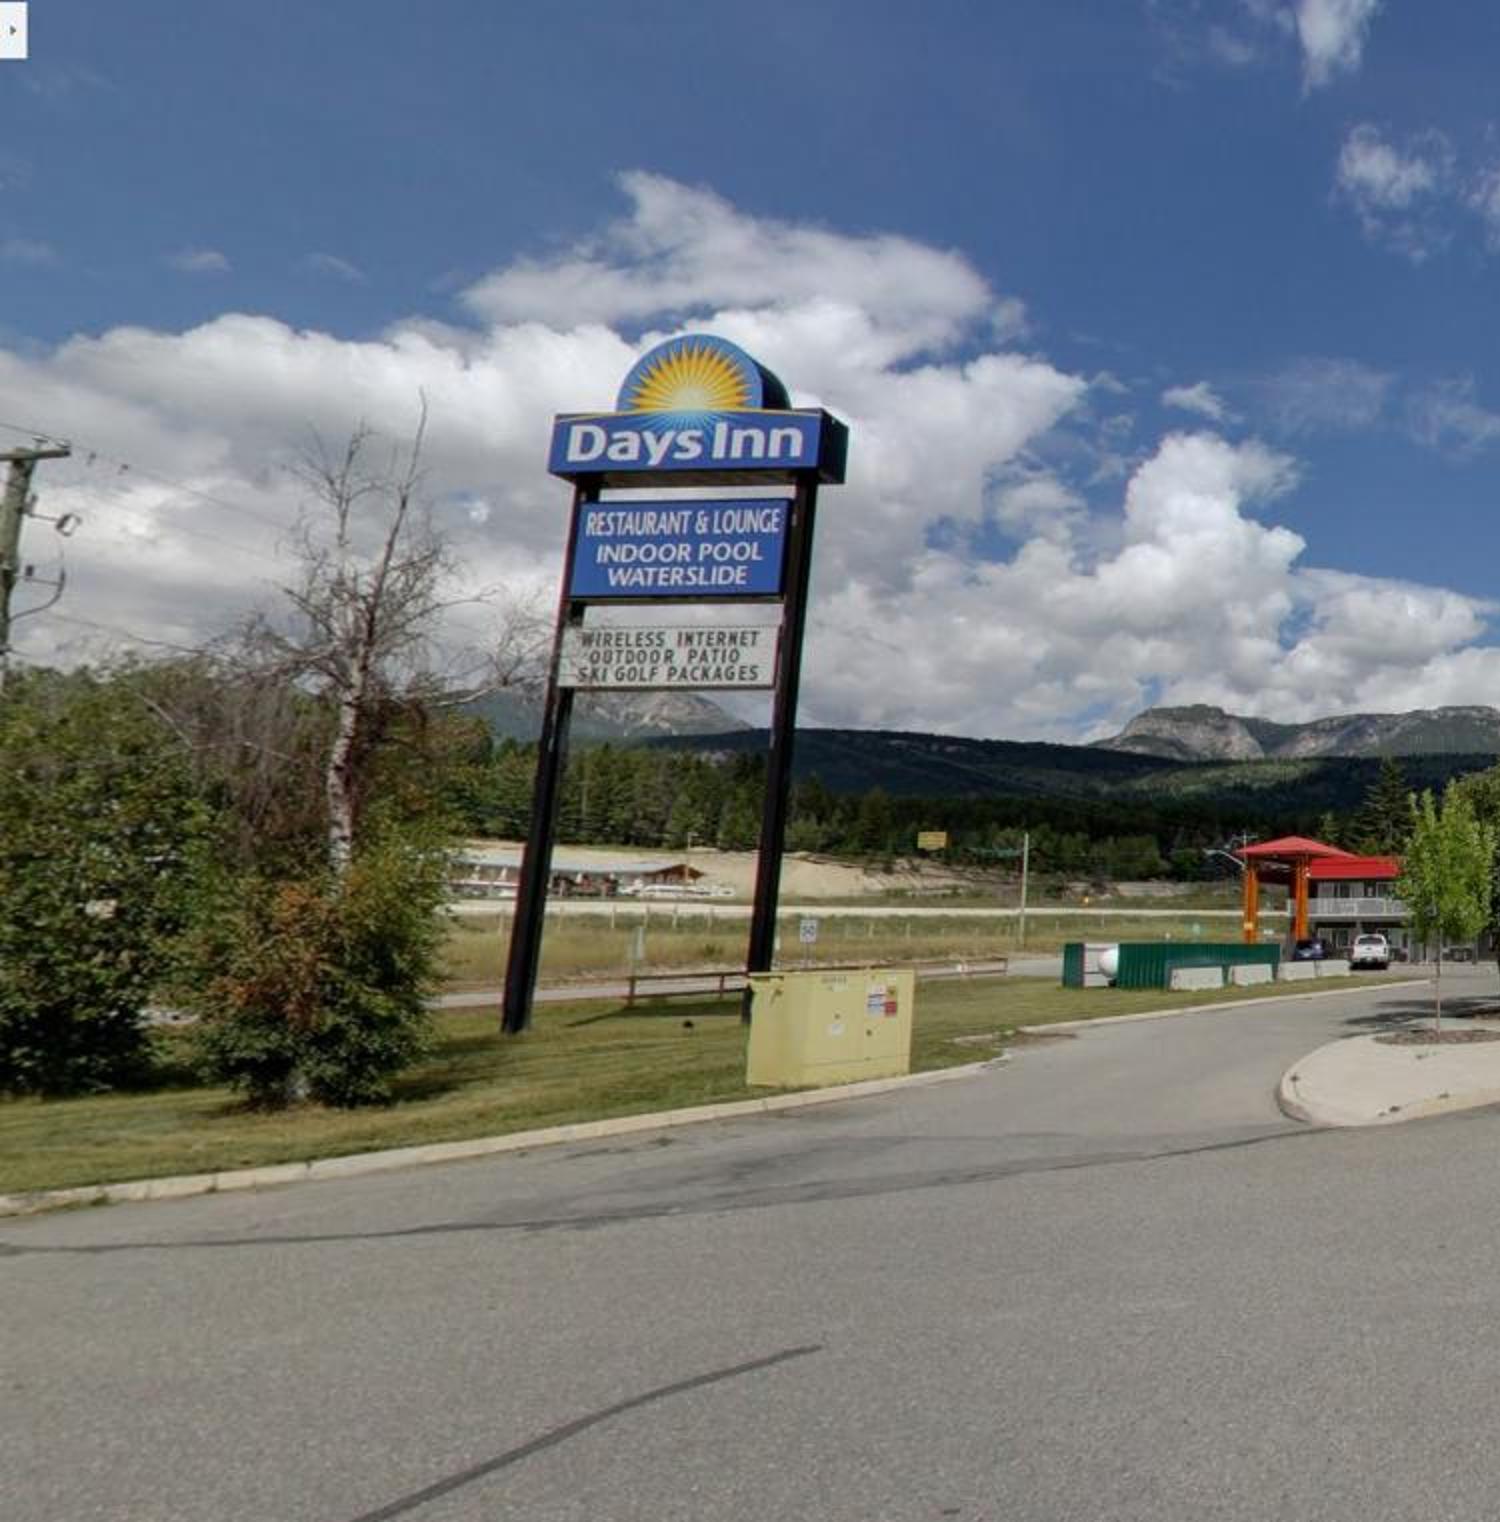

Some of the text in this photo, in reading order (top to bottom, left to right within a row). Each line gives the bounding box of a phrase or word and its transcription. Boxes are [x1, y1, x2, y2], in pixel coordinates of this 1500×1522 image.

[566, 421, 804, 465] Days Inn
[585, 508, 781, 536] RESTAURANT & LOUNGE
[596, 541, 764, 564] INDOOR POOL
[607, 565, 749, 587] WATERSLIDE
[580, 630, 761, 648] WIRELESS INTERNET
[588, 648, 741, 665] OUTDOOR PATIO
[577, 664, 759, 682] SKI GOLF PACKAGES
